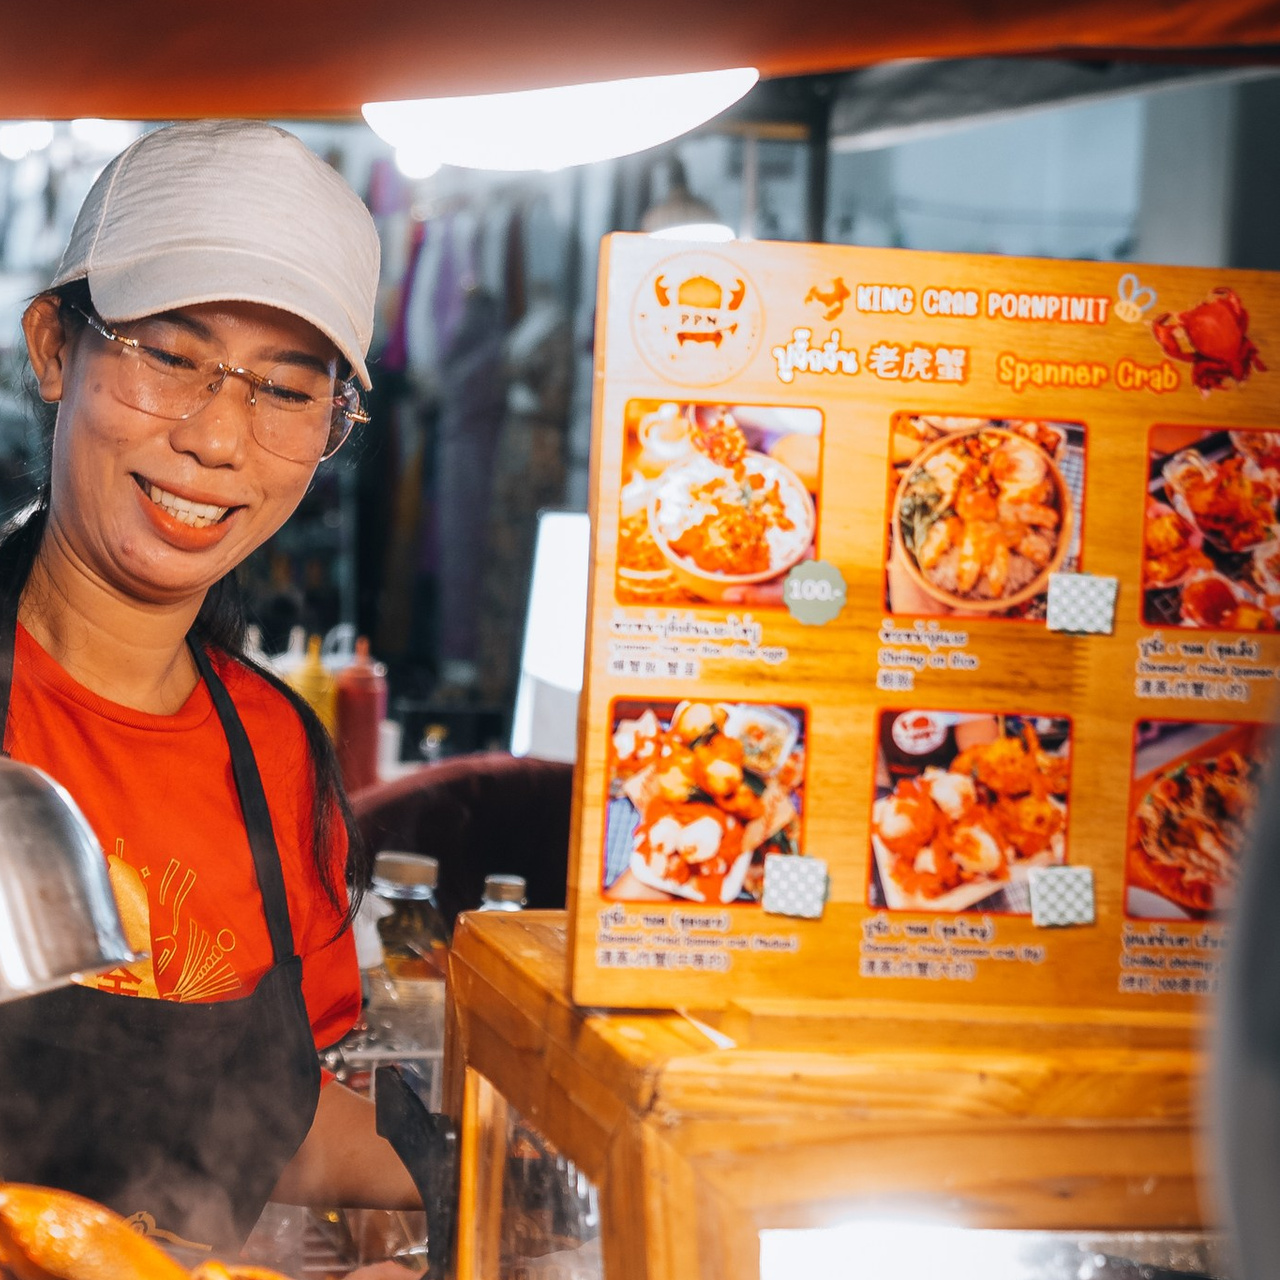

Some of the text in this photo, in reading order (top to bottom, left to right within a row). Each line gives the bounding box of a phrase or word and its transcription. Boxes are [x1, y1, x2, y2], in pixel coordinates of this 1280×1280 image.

[857, 285, 1110, 322] KING CRAB PORNPINIT
[870, 344, 967, 381] 老虎蟹
[998, 354, 1178, 392] Spanner Crab
